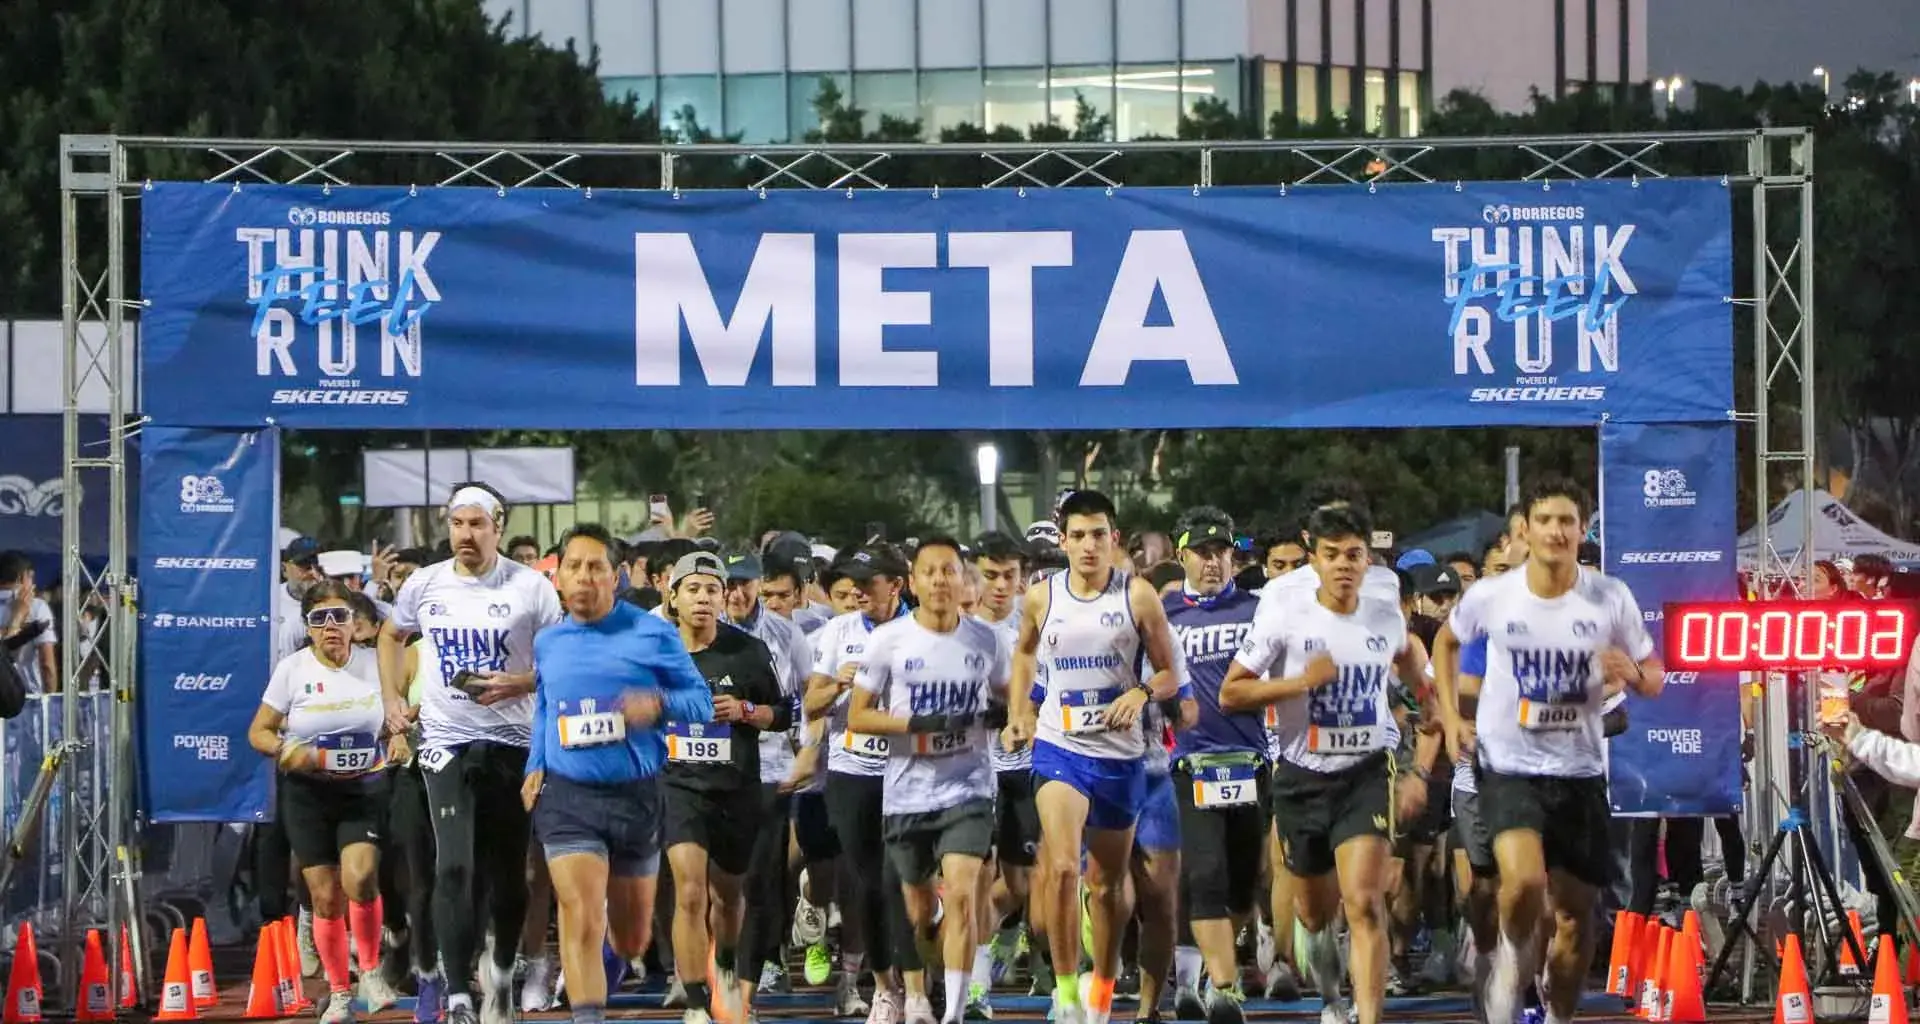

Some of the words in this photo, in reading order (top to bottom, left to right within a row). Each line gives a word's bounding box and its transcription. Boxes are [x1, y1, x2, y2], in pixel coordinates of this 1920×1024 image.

[318, 210, 391, 225] BORREGOS
[1512, 206, 1584, 221] BORREGOS
[237, 228, 442, 301] THINK
[1432, 225, 1638, 296] THINK
[246, 265, 432, 337] FEEL
[1444, 262, 1628, 336] FEEL
[635, 230, 1240, 386] META
[256, 308, 422, 376] RUN
[1454, 303, 1618, 374] RUN
[1516, 376, 1547, 385] POWERED
[1549, 376, 1558, 384] BY
[272, 390, 409, 405] SKECHERS
[1469, 386, 1606, 402] SKECHERS
[155, 557, 257, 569] SKECHERS
[1619, 551, 1723, 564] SKECHERS
[176, 616, 257, 628] BANORTE
[429, 627, 510, 658] THINK
[1193, 651, 1230, 665] RUNNING
[1506, 647, 1594, 677] THINK
[174, 672, 231, 691] telcel
[905, 681, 984, 710] THINK
[581, 719, 614, 736] 421
[1647, 729, 1701, 742] POWER
[174, 735, 228, 749] POWER
[864, 737, 889, 752] 40
[1328, 731, 1371, 748] 1142
[1672, 741, 1702, 753] ADE
[198, 748, 228, 760] ADE
[686, 742, 719, 758] 198
[336, 752, 369, 767] 587
[1220, 784, 1242, 800] 57
